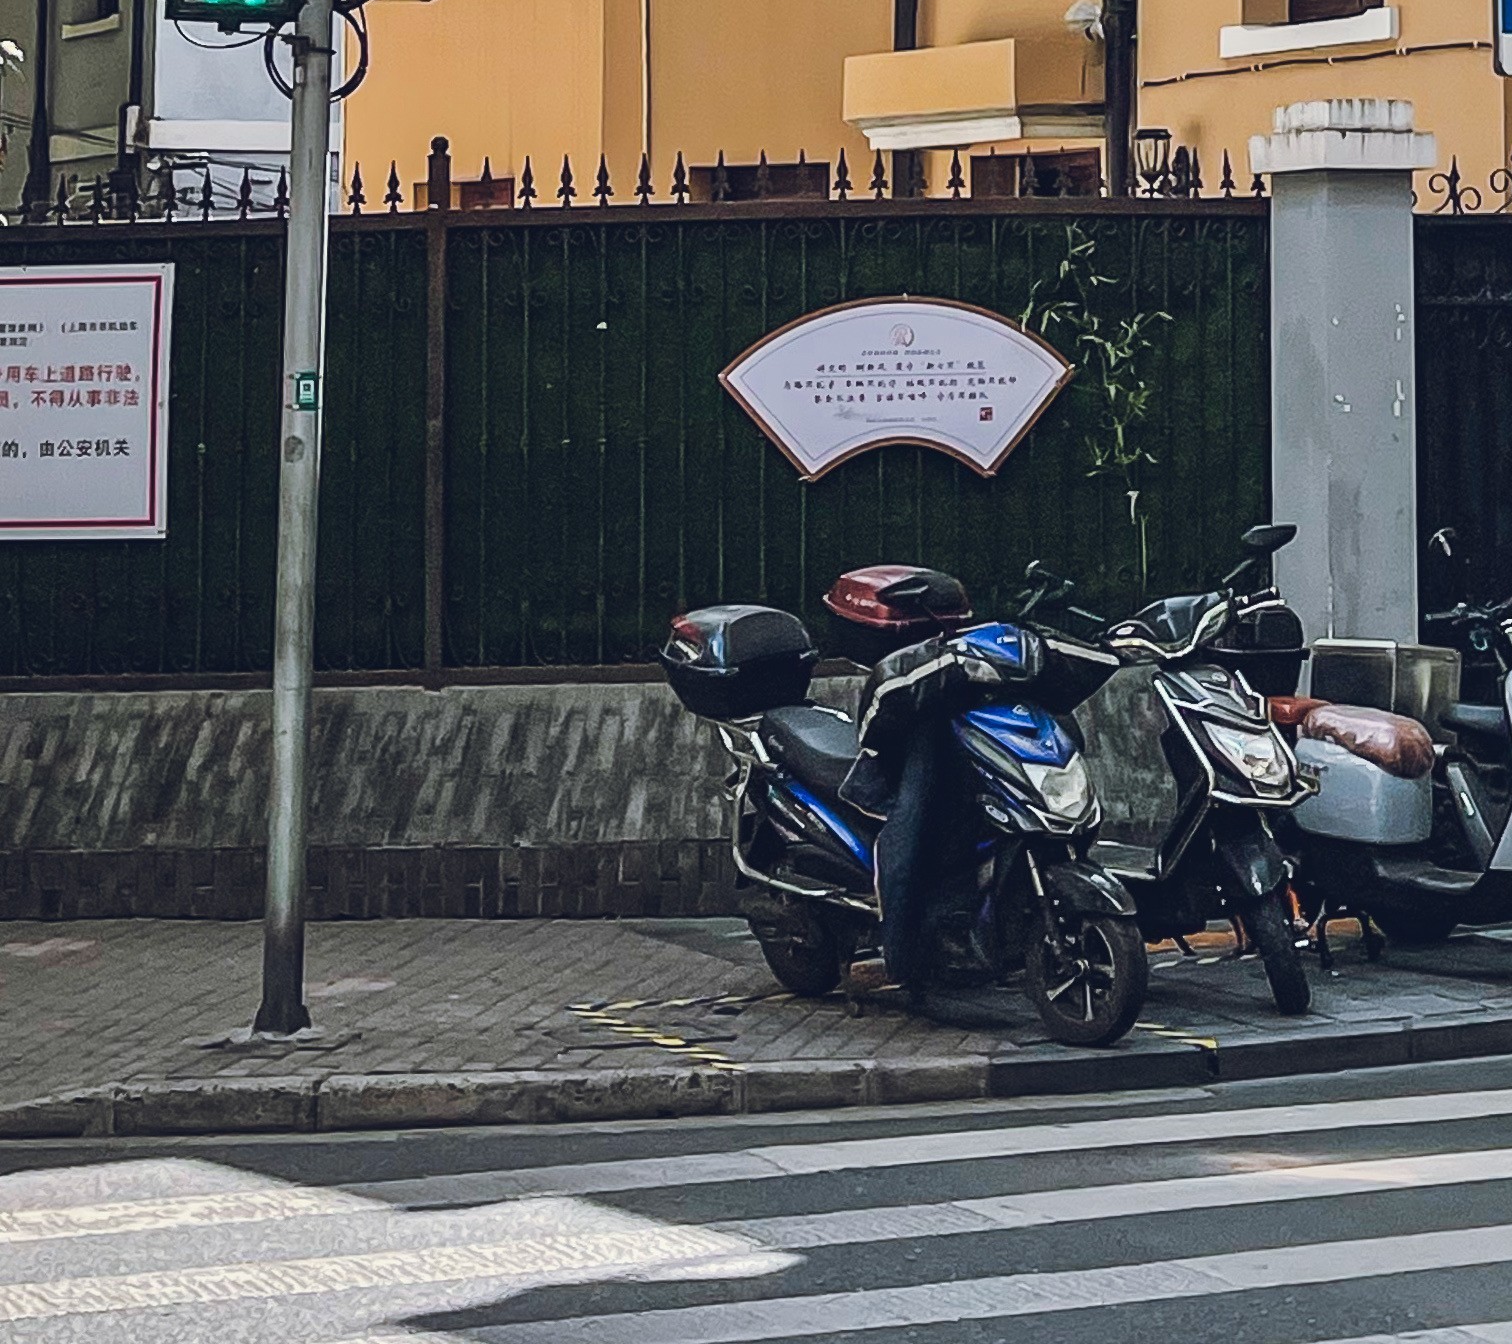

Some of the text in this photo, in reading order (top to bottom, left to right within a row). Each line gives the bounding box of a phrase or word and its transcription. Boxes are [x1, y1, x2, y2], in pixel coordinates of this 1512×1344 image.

[0, 363, 140, 383] 用车上道路行驶。
